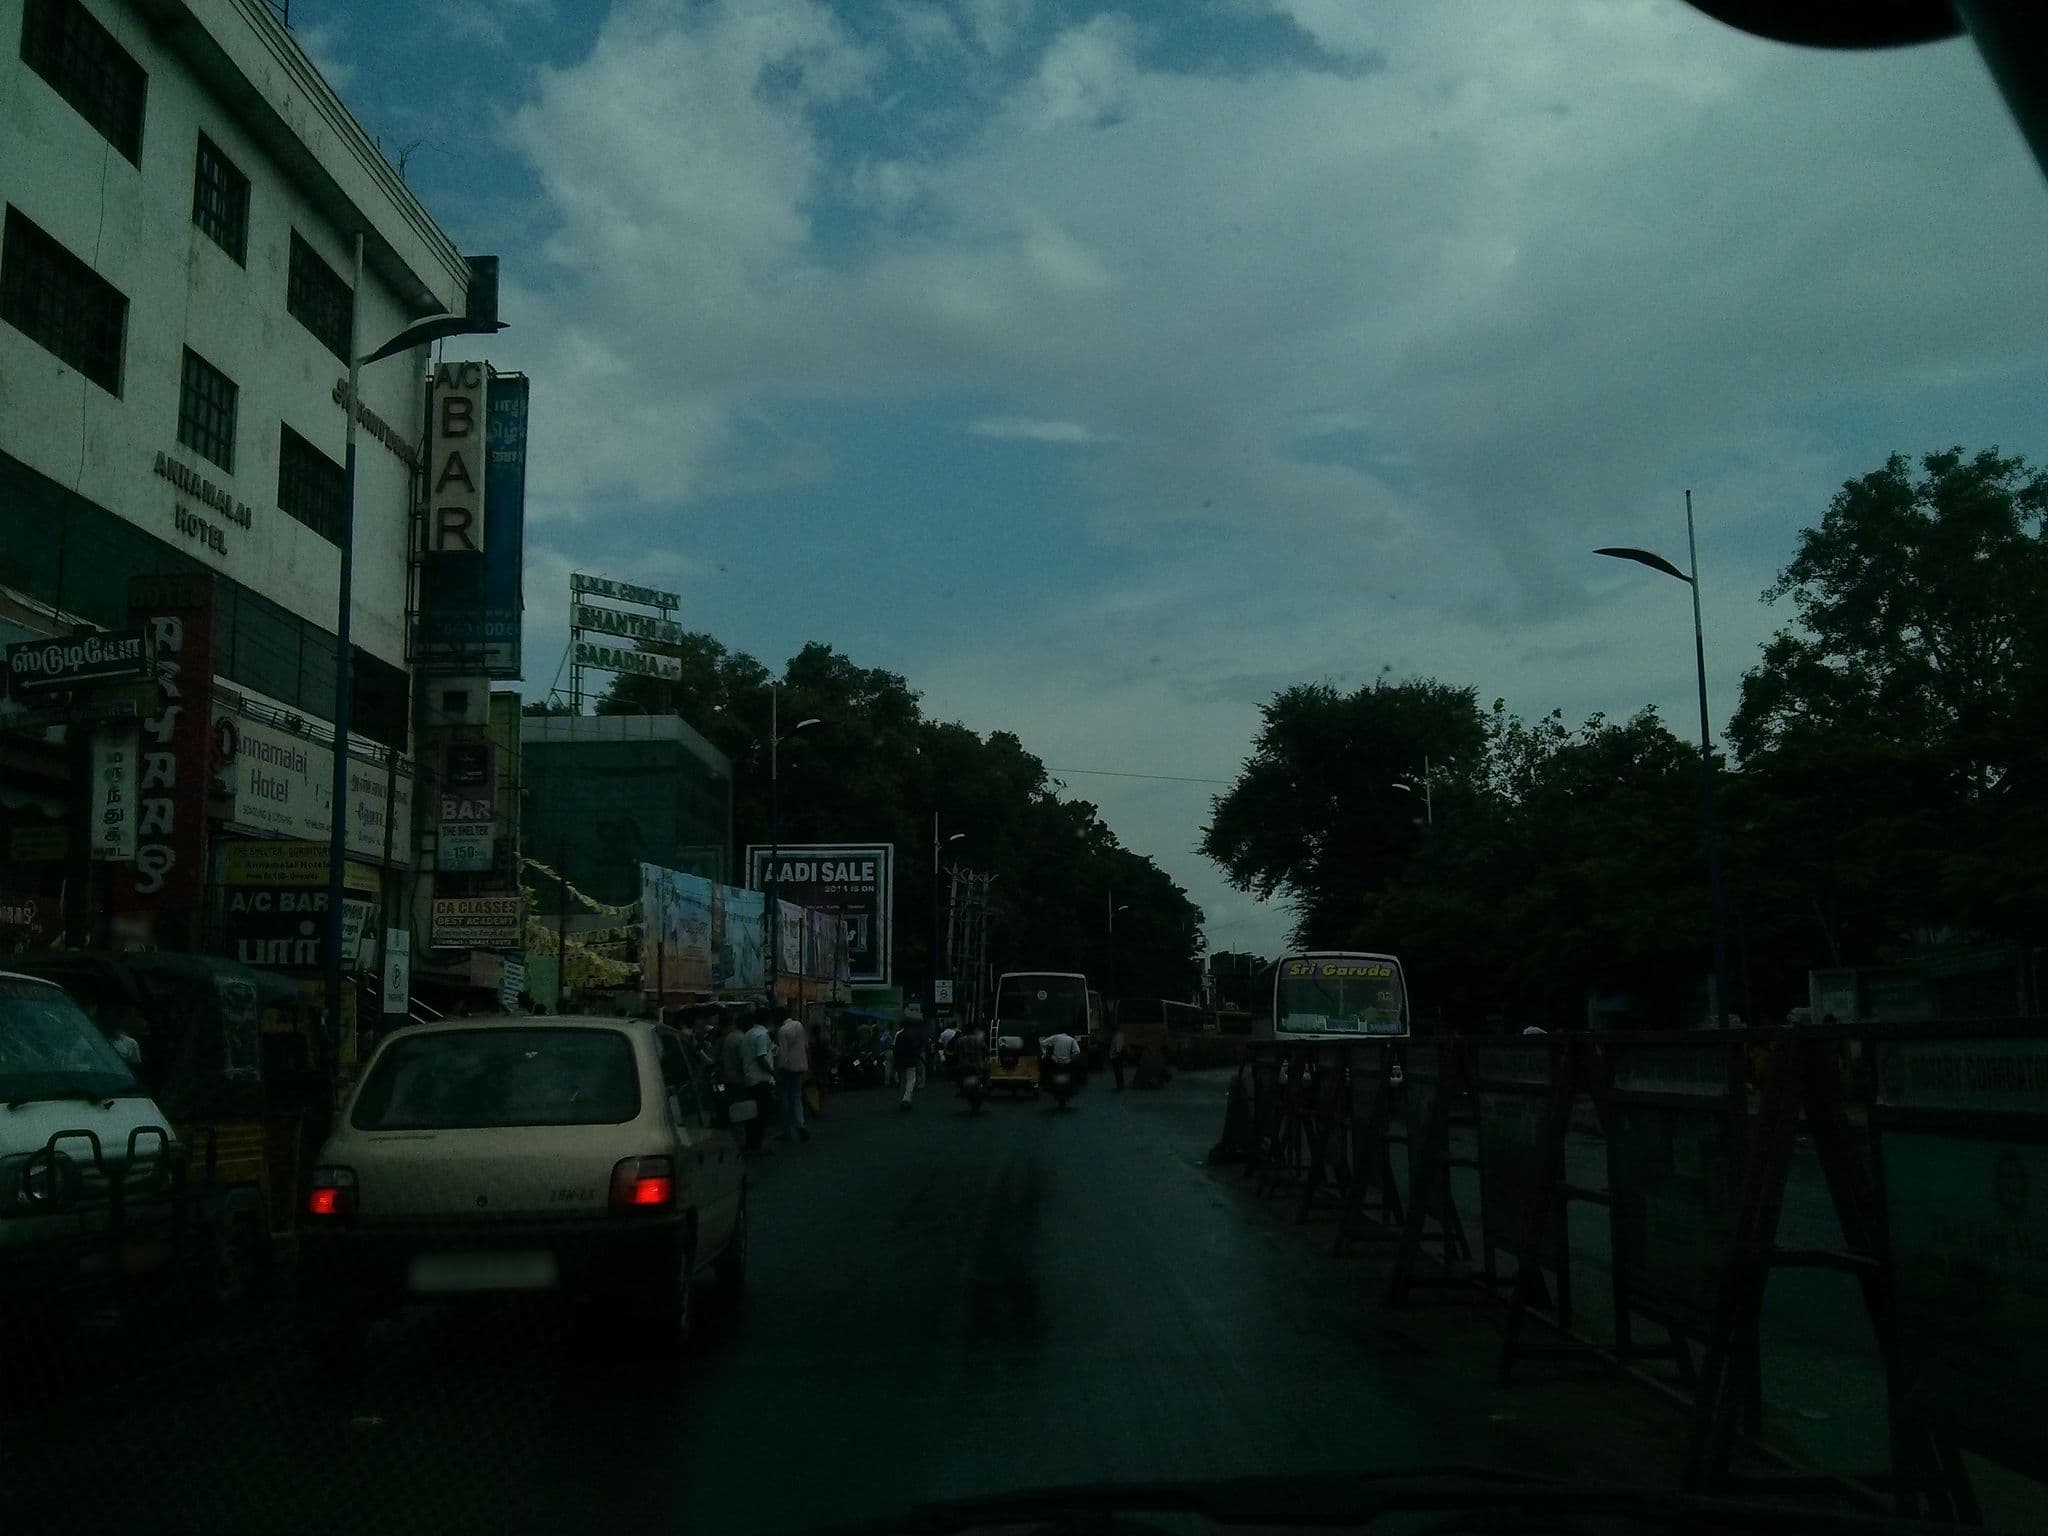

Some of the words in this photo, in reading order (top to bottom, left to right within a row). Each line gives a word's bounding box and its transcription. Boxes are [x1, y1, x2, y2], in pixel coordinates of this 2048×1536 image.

[435, 363, 480, 389] A/C
[435, 396, 475, 549] BAR
[154, 451, 252, 529] ANNAMALAI
[175, 503, 227, 555] HOTEL
[578, 606, 657, 638] SHANTHI
[11, 636, 142, 675] ஸ்டுடியோ
[576, 643, 659, 674] SARADHA
[251, 768, 288, 804] Hotel
[442, 799, 491, 819] BAR
[821, 861, 875, 882] SALE
[230, 890, 272, 914] A/C
[279, 891, 328, 913] BAR
[458, 900, 516, 914] CLASSES
[1288, 962, 1318, 977] Sri
[1322, 963, 1393, 978] Garuda
